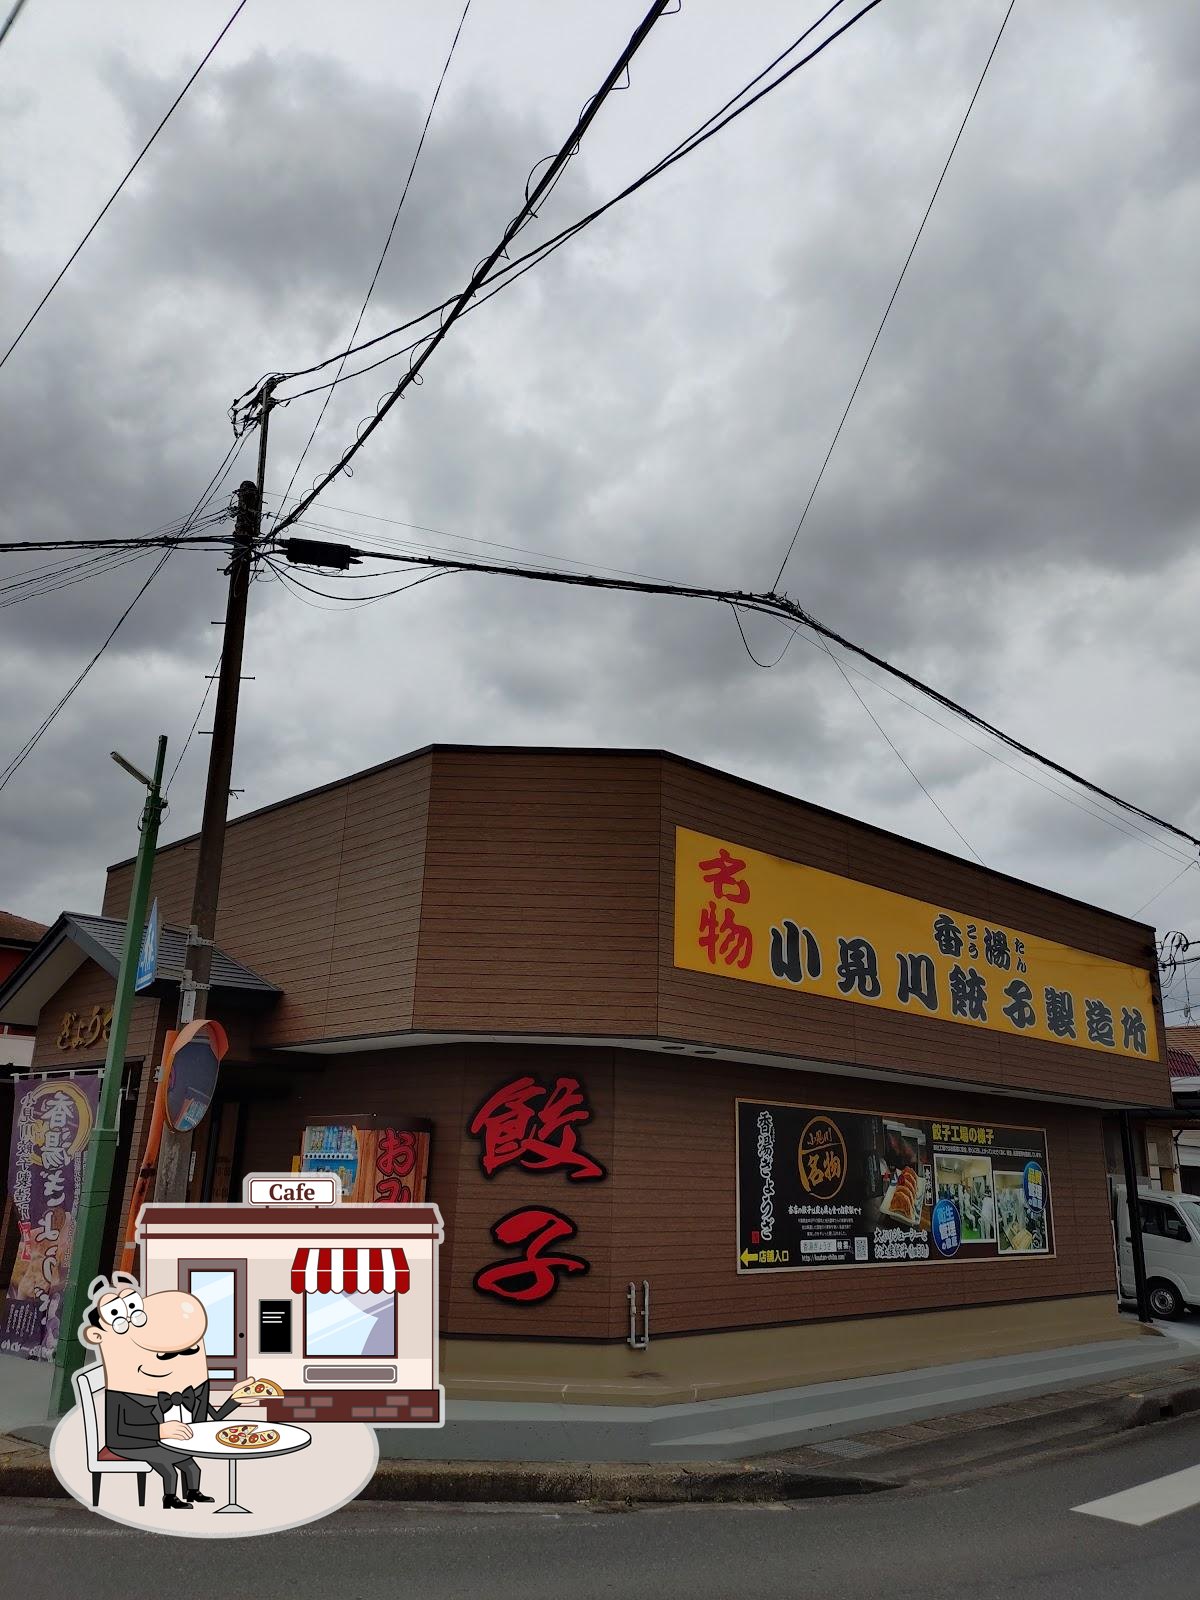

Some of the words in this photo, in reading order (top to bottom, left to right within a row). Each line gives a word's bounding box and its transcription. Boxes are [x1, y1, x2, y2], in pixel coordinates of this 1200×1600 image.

[699, 848, 753, 969] 名物
[769, 919, 1148, 1055] 小見川餃子製造所
[471, 1076, 607, 1304] 餃子
[757, 1110, 775, 1241] 香湯ぎょうざ
[932, 1122, 995, 1145] 餃子工場の様子
[759, 1249, 789, 1263] 店舗入口
